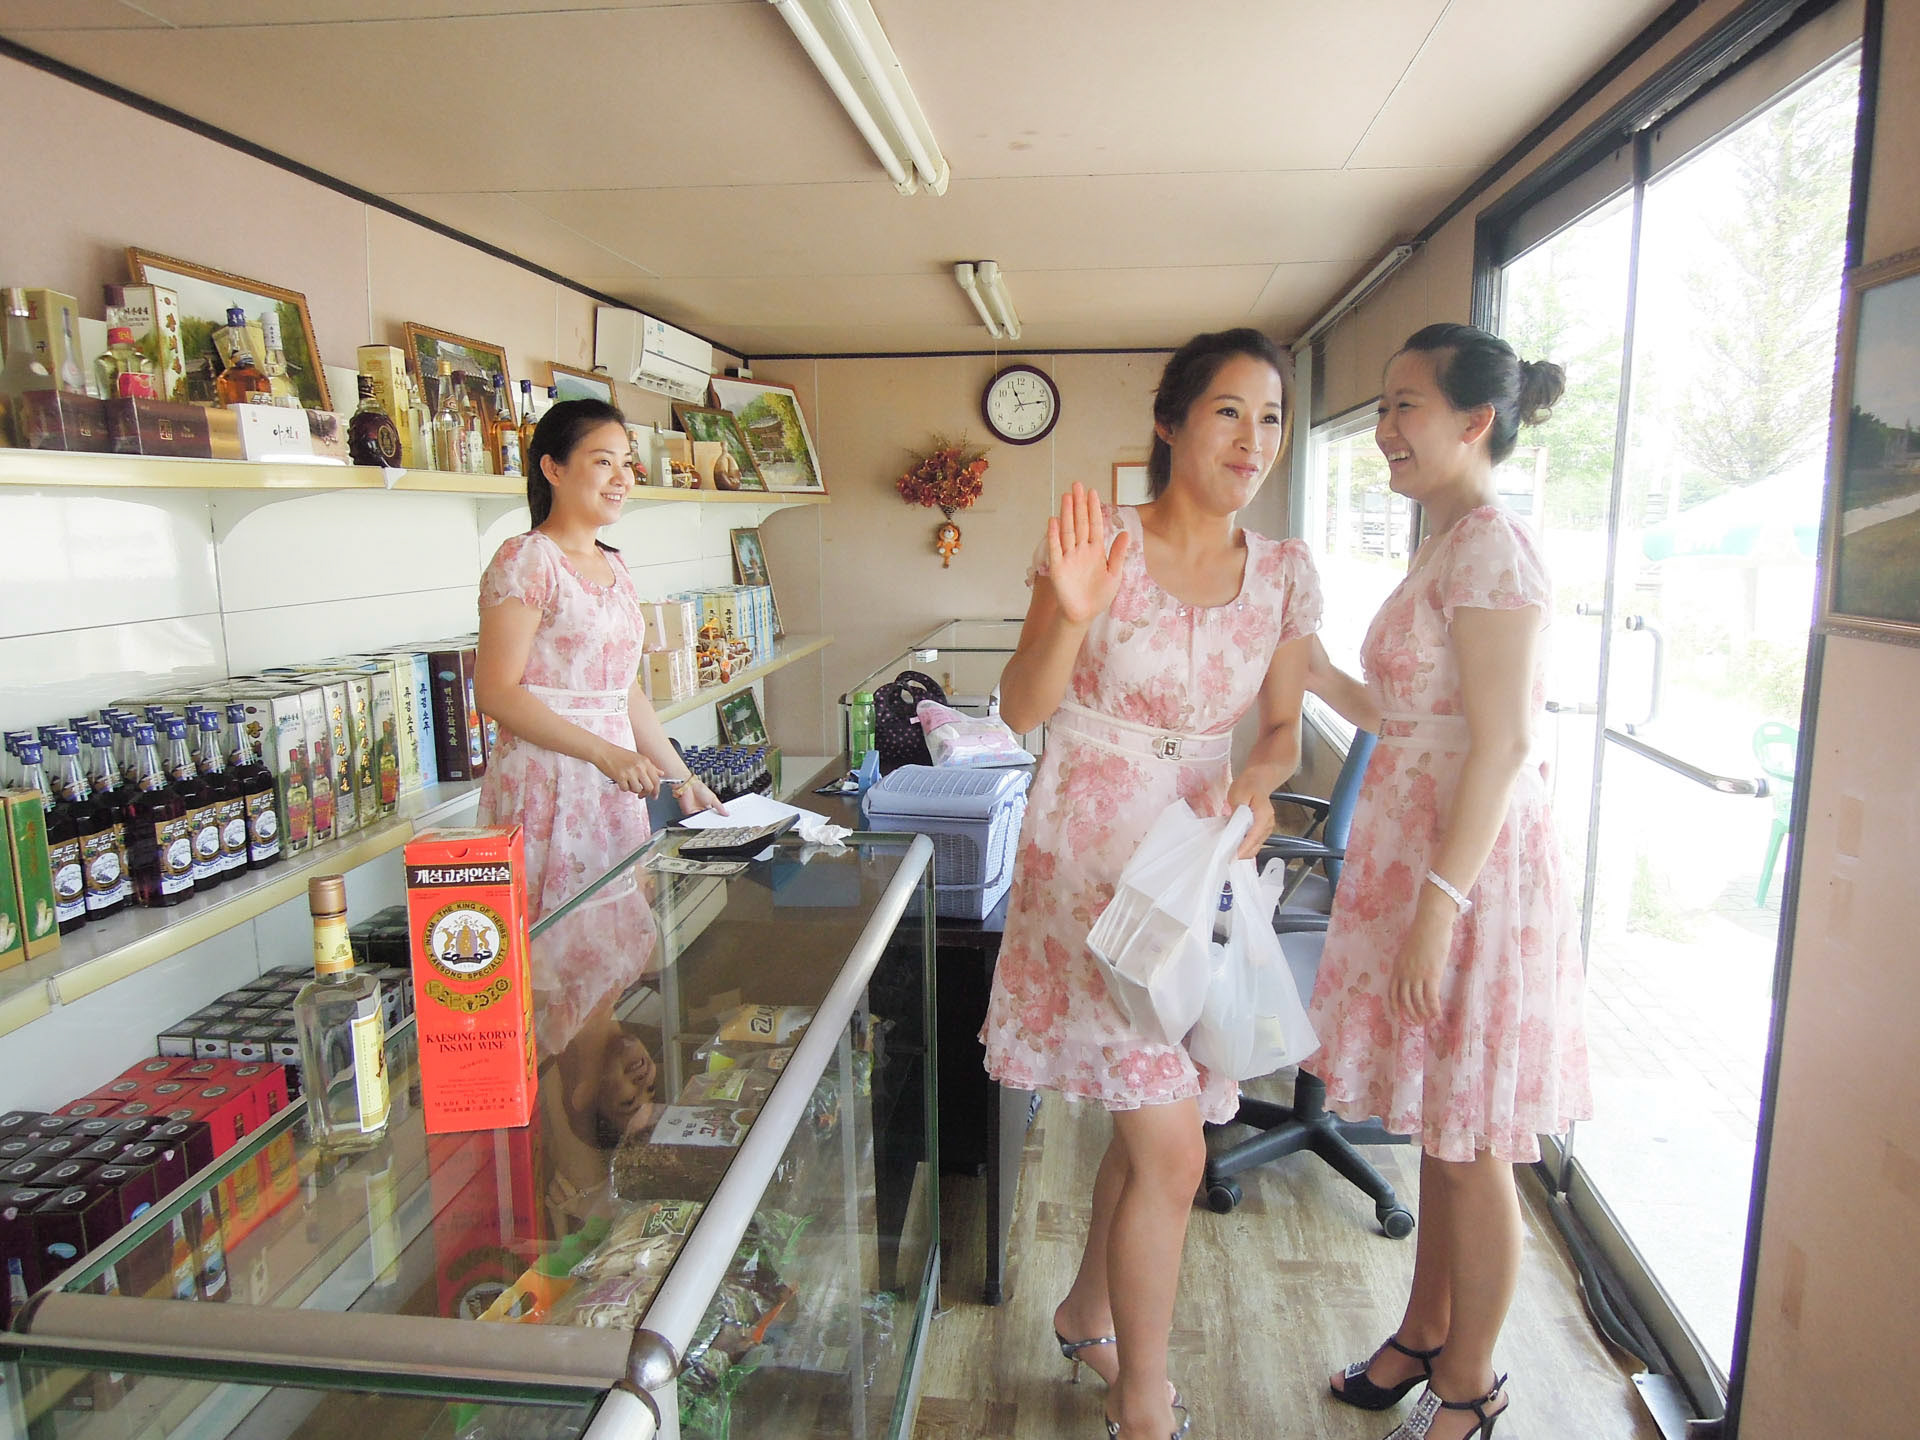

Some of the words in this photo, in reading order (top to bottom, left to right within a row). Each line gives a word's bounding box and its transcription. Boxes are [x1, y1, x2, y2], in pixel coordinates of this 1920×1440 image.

[1017, 378, 1025, 386] 12
[1000, 390, 1007, 398] 10
[998, 413, 1003, 421] 8
[1008, 422, 1013, 430] 7
[1019, 424, 1024, 432] 6
[1030, 422, 1036, 430] 5
[415, 866, 510, 885] 개성고려인삼술
[425, 922, 436, 946] INSAM
[438, 905, 454, 919] THE
[456, 902, 476, 911] KING
[479, 905, 491, 914] OF
[492, 914, 506, 940] HERBS
[428, 952, 463, 979] KAESONG
[467, 948, 506, 979] SPECIALITY
[426, 1032, 476, 1044] KAESONG
[479, 1030, 517, 1041] KORYO
[439, 1042, 473, 1053] INSAM
[477, 1041, 505, 1050] WINE
